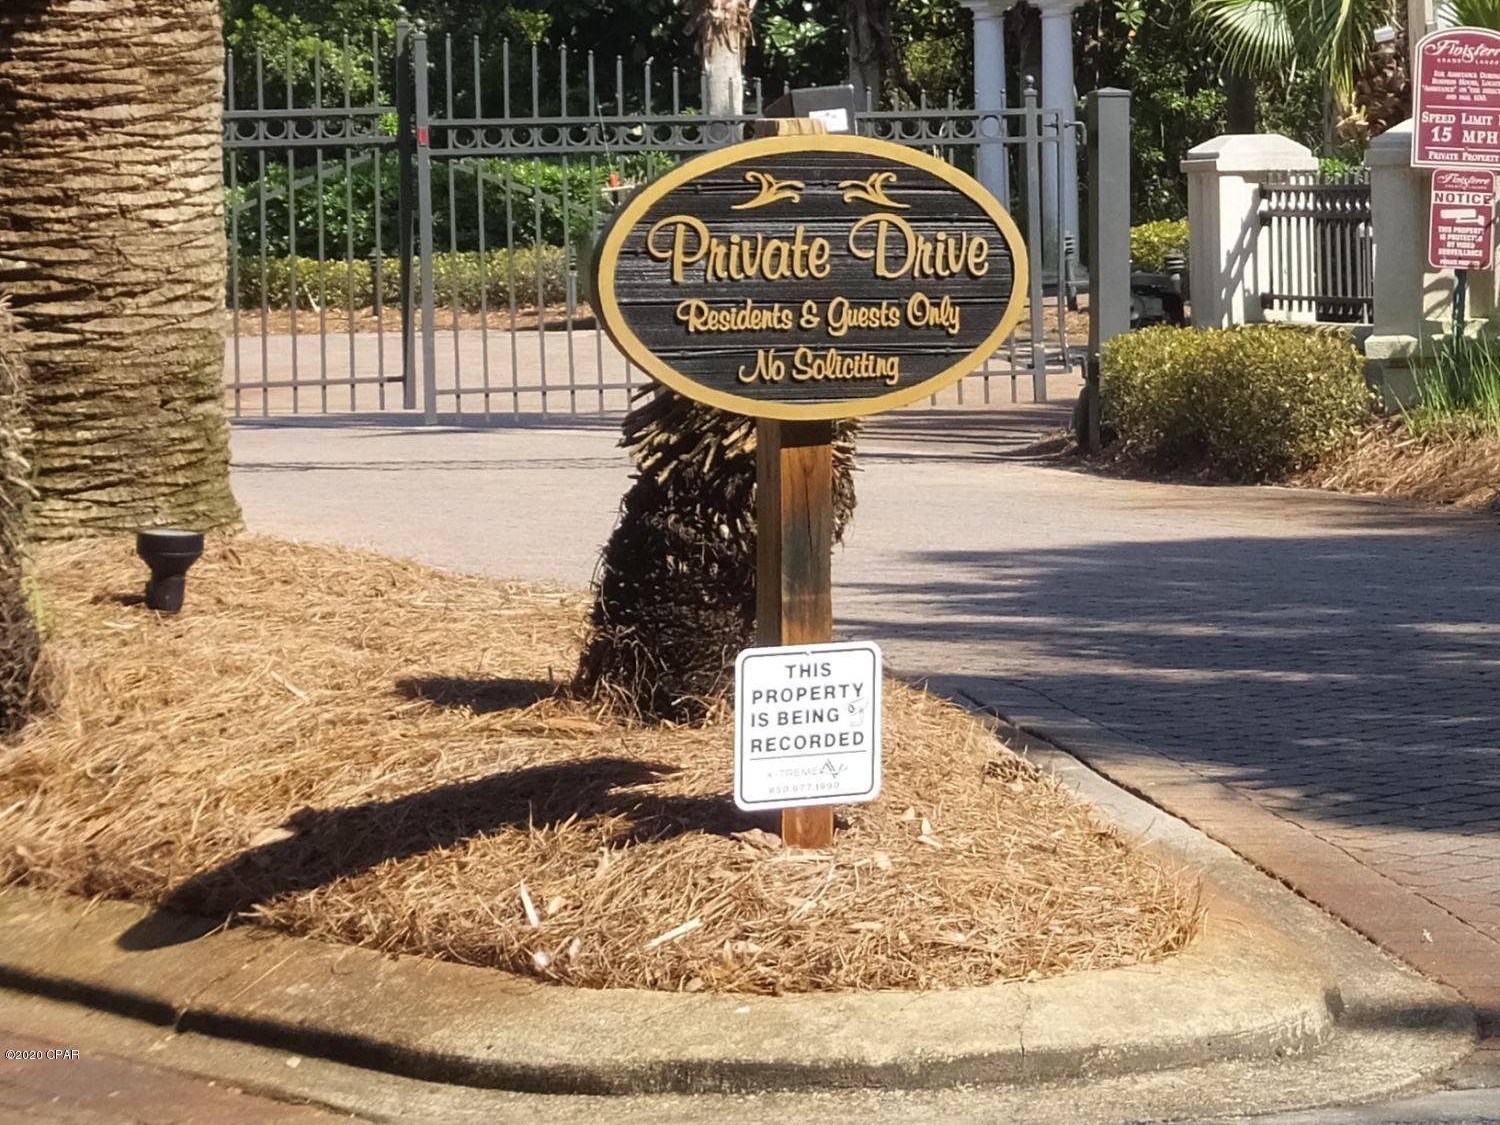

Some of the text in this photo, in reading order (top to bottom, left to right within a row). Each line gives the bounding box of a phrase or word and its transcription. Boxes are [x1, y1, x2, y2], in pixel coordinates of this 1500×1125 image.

[1421, 111, 1456, 124] SPEED
[1461, 113, 1493, 126] LIMIT
[1431, 126, 1499, 145] 15 MPH
[1434, 192, 1493, 204] NOTICE
[647, 212, 990, 283] Private Drive
[676, 291, 961, 337] Residents & Guests Only
[738, 346, 900, 386] No Soliciting
[785, 662, 832, 679] THIS
[752, 682, 864, 705] PROPERTY
[750, 708, 840, 728] IS BEING
[750, 731, 865, 753] RECORDED
